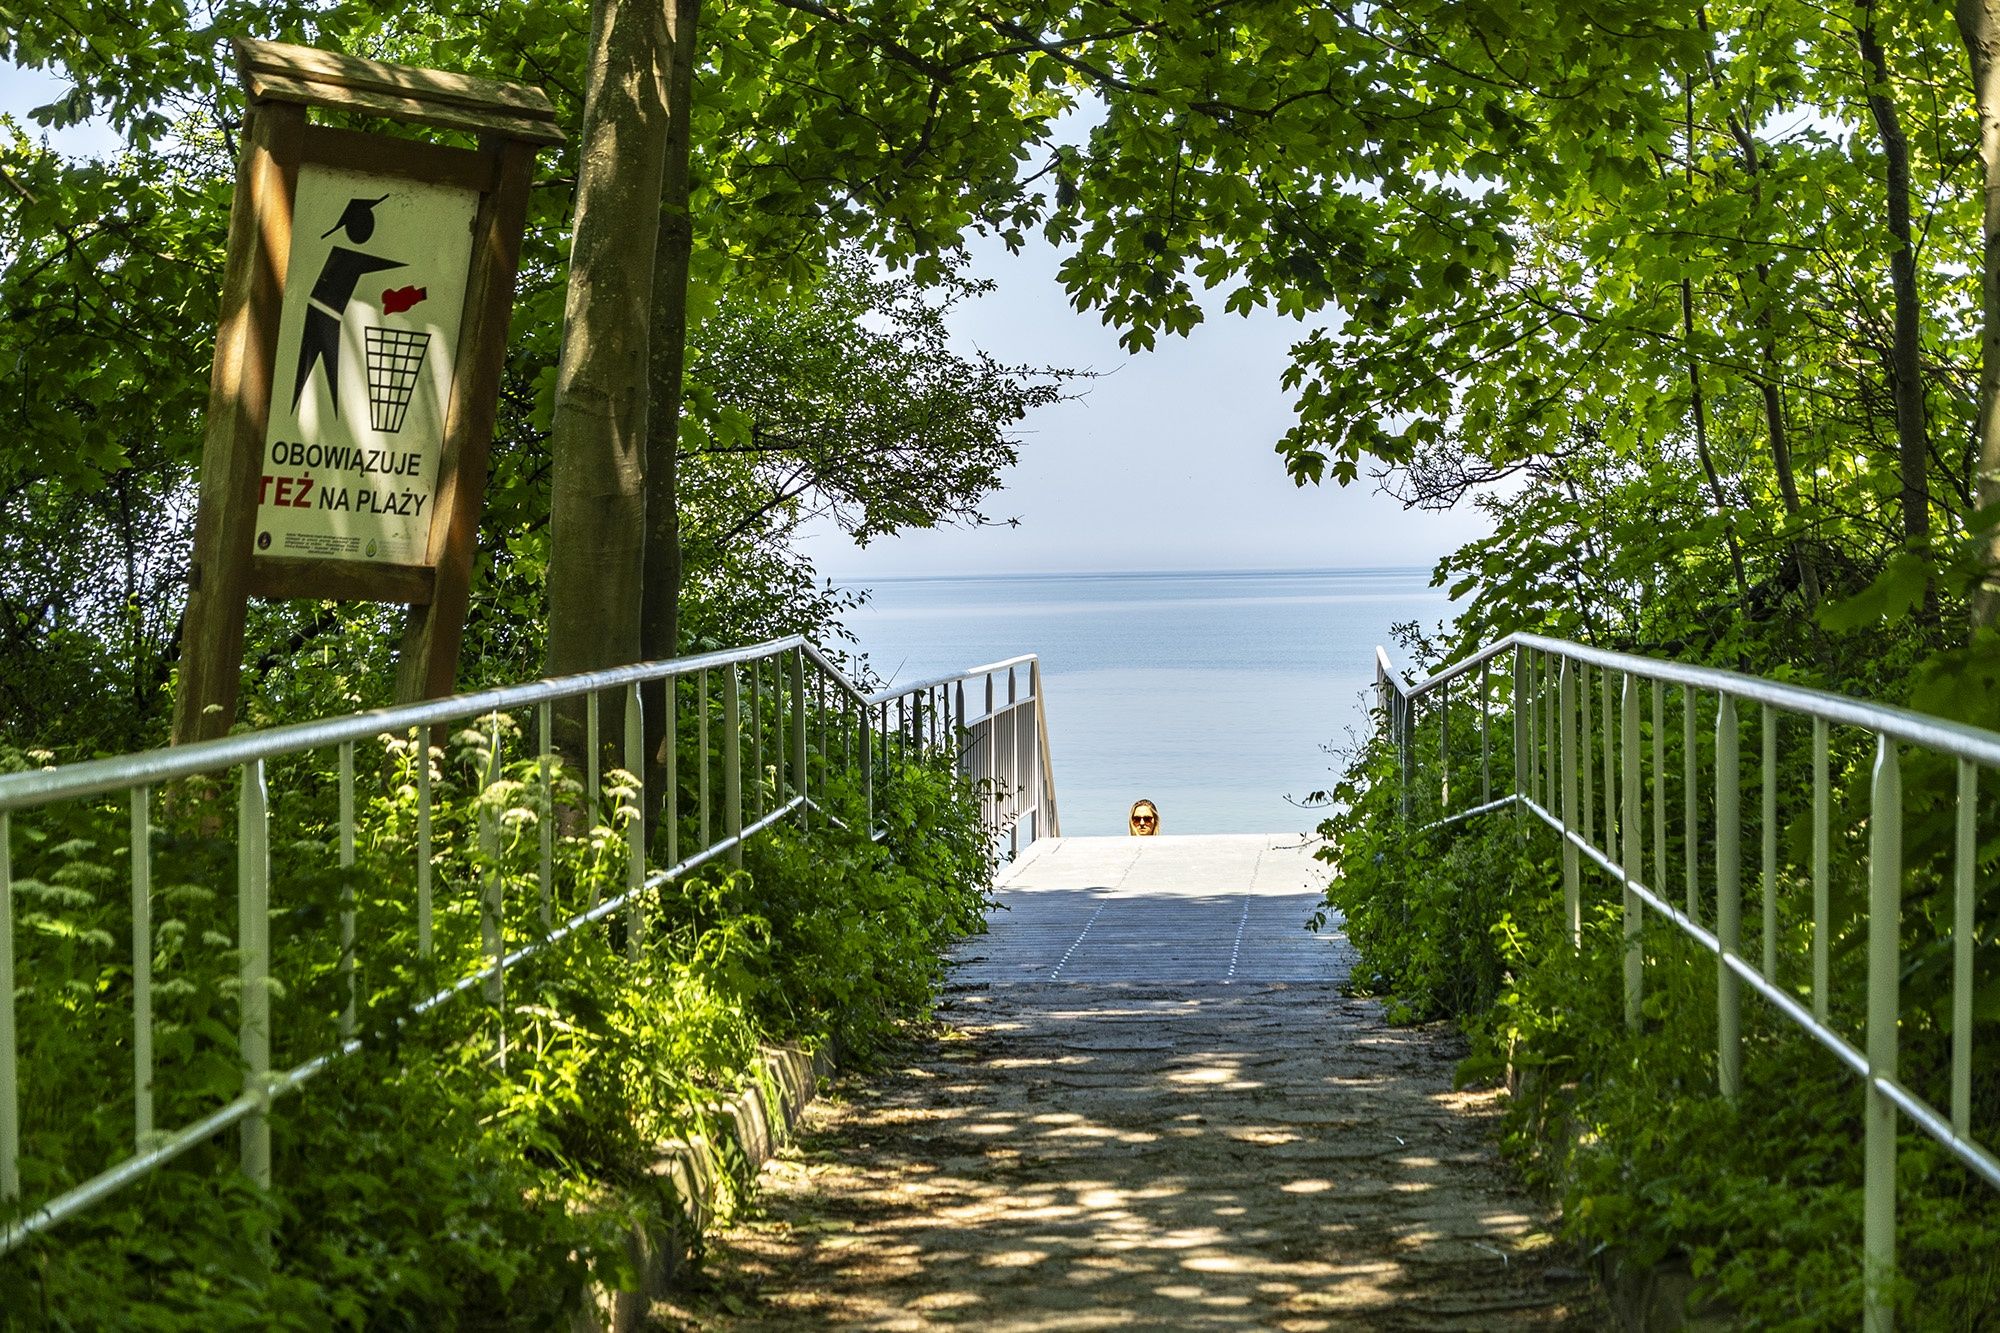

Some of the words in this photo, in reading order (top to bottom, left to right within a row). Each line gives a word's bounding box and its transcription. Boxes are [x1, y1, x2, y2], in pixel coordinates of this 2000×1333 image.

[271, 441, 422, 477] OBOWIĄZUJE
[258, 471, 314, 508] TEŻ
[319, 486, 350, 511] NA
[356, 488, 427, 517] PLAŻY
